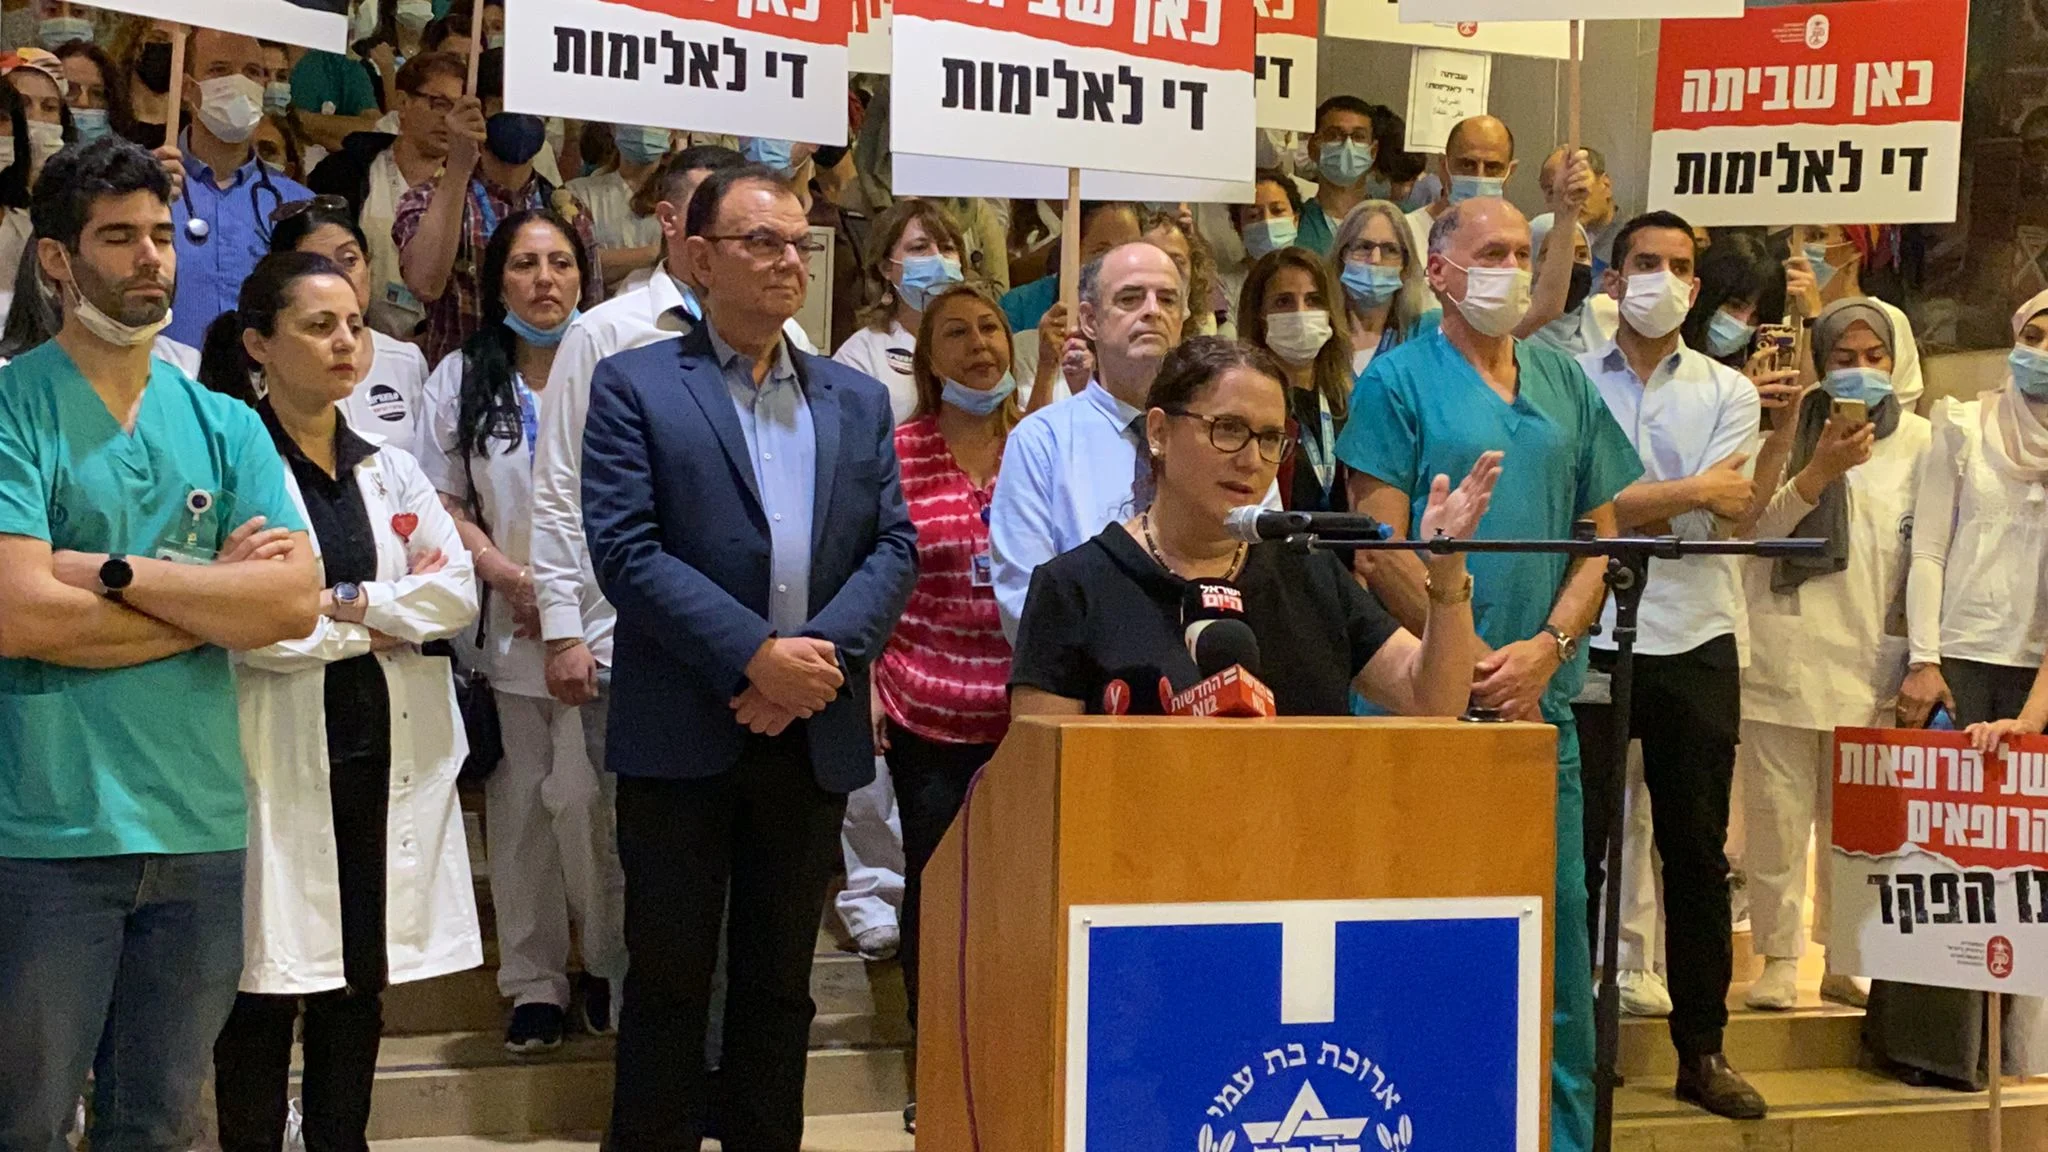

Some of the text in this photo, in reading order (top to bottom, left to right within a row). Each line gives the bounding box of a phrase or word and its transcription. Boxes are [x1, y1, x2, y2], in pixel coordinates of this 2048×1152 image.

[553, 26, 808, 99] די לאלימות
[1254, 55, 1293, 98] די
[1681, 60, 1934, 116] כאן שביתה
[941, 58, 1208, 131] די לאלימות
[1674, 140, 1928, 195] די לאלימות
[1200, 584, 1241, 597] ישראל
[1202, 593, 1245, 613] היום
[1171, 675, 1221, 713] החדשות
[1838, 742, 1984, 793] הרופאות
[1907, 799, 2048, 854] הרופאים
[1867, 872, 1997, 934] הפקר
[1206, 1041, 1401, 1118] ארוכת בת עמי
